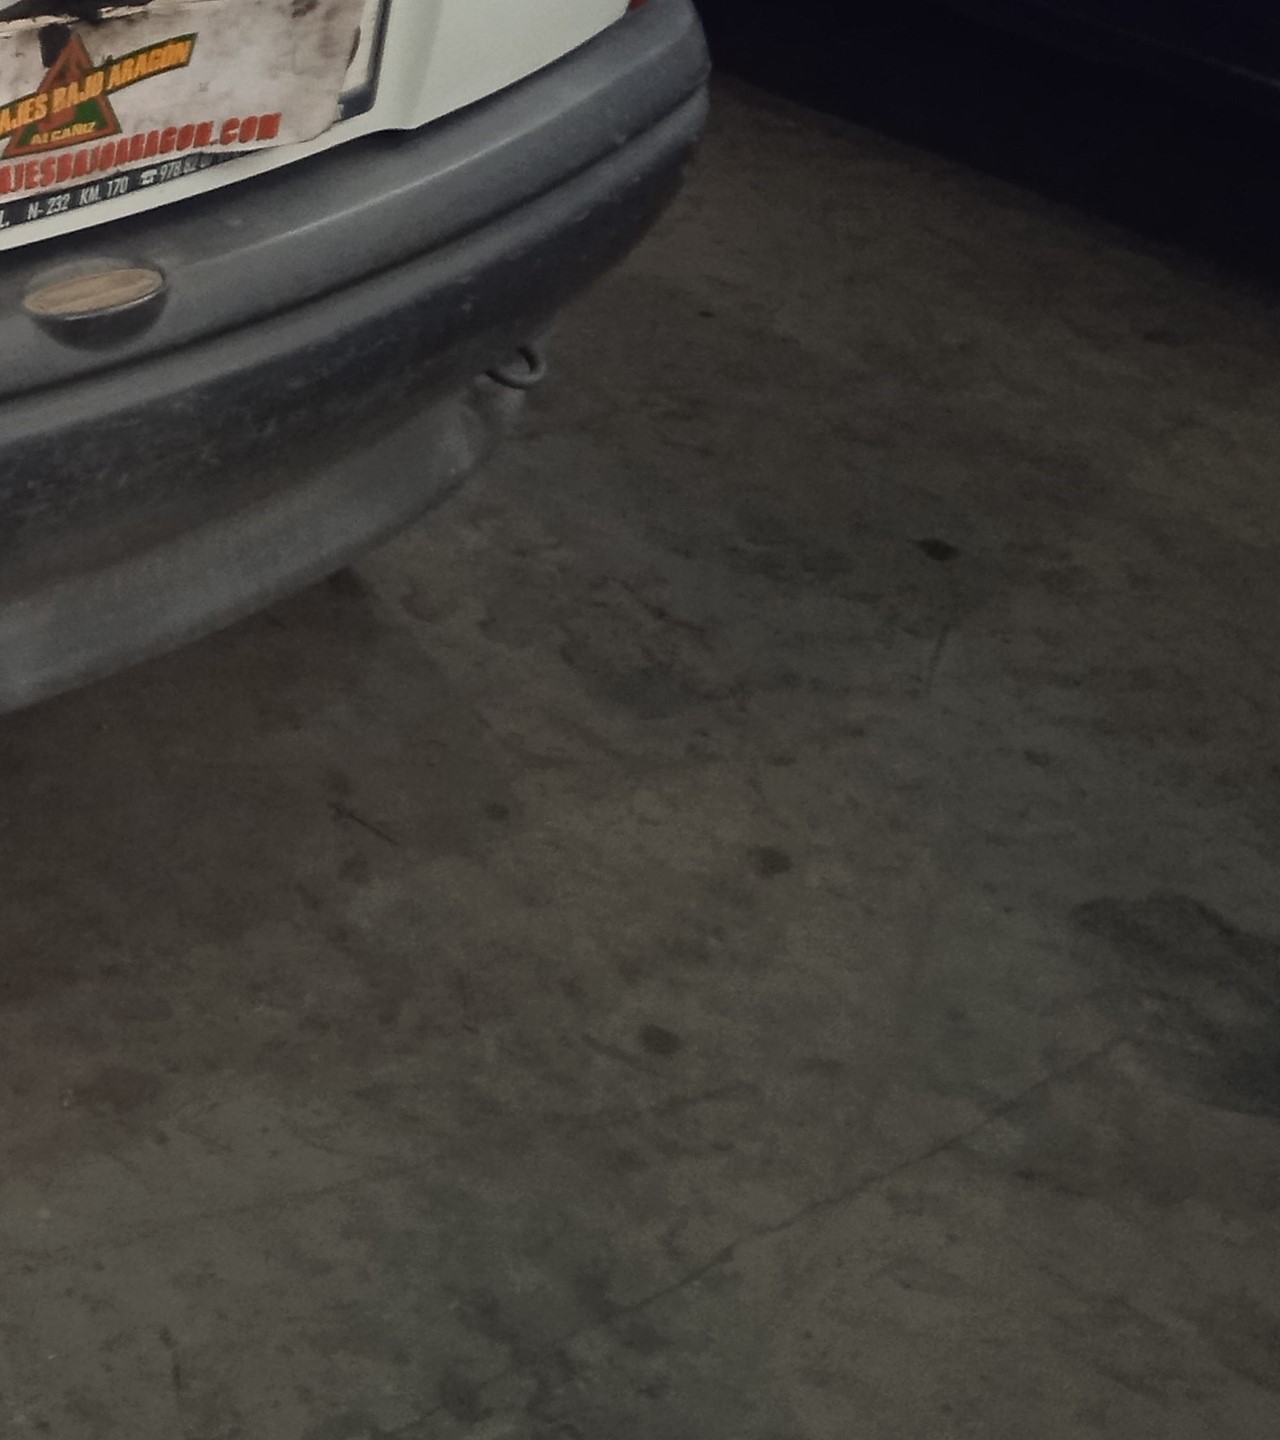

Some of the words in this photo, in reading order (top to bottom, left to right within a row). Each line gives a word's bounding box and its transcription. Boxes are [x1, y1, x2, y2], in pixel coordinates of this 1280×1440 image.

[51, 70, 105, 113] BAJO
[106, 177, 129, 200] 170
[159, 159, 182, 183] 978
